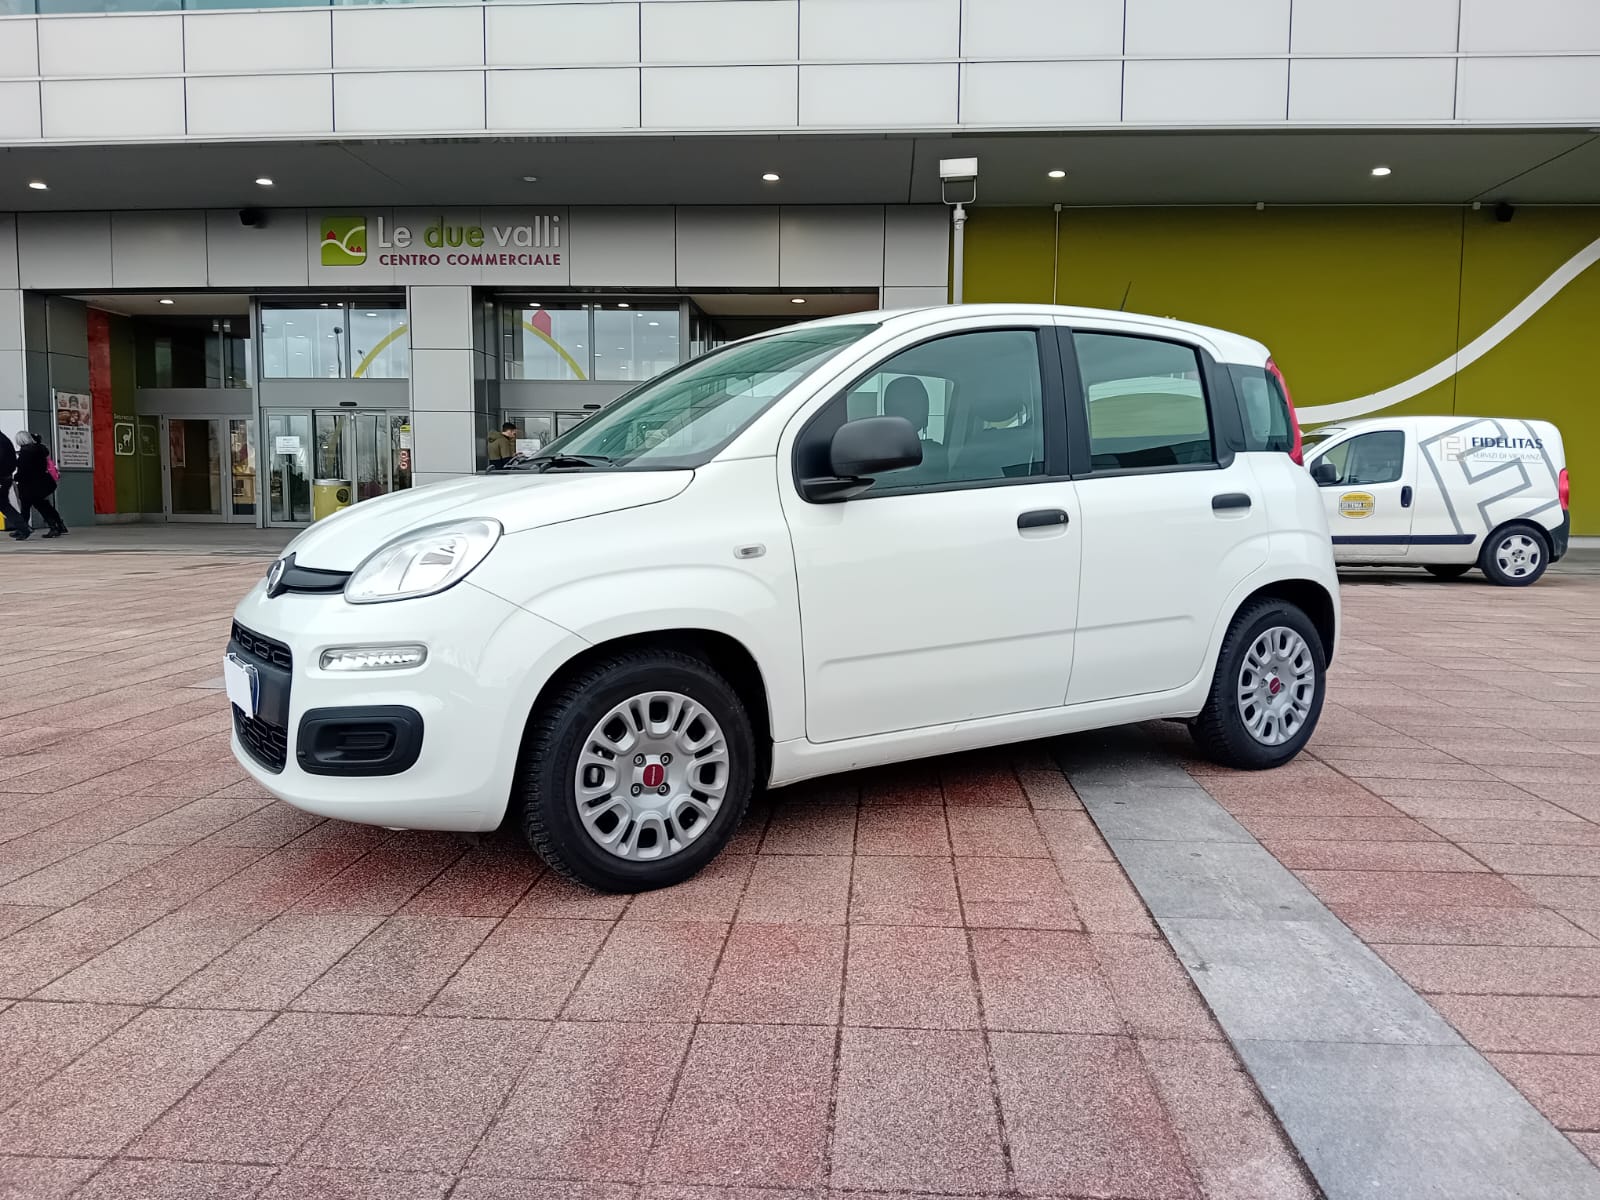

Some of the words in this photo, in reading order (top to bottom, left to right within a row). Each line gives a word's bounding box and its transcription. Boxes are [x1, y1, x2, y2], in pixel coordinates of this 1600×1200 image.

[377, 217, 412, 248] Le
[423, 216, 485, 248] due
[492, 215, 561, 248] valli
[379, 254, 440, 266] CENTRO
[447, 253, 561, 266] COMMERCIALE
[1472, 437, 1543, 450] FIDELITAS
